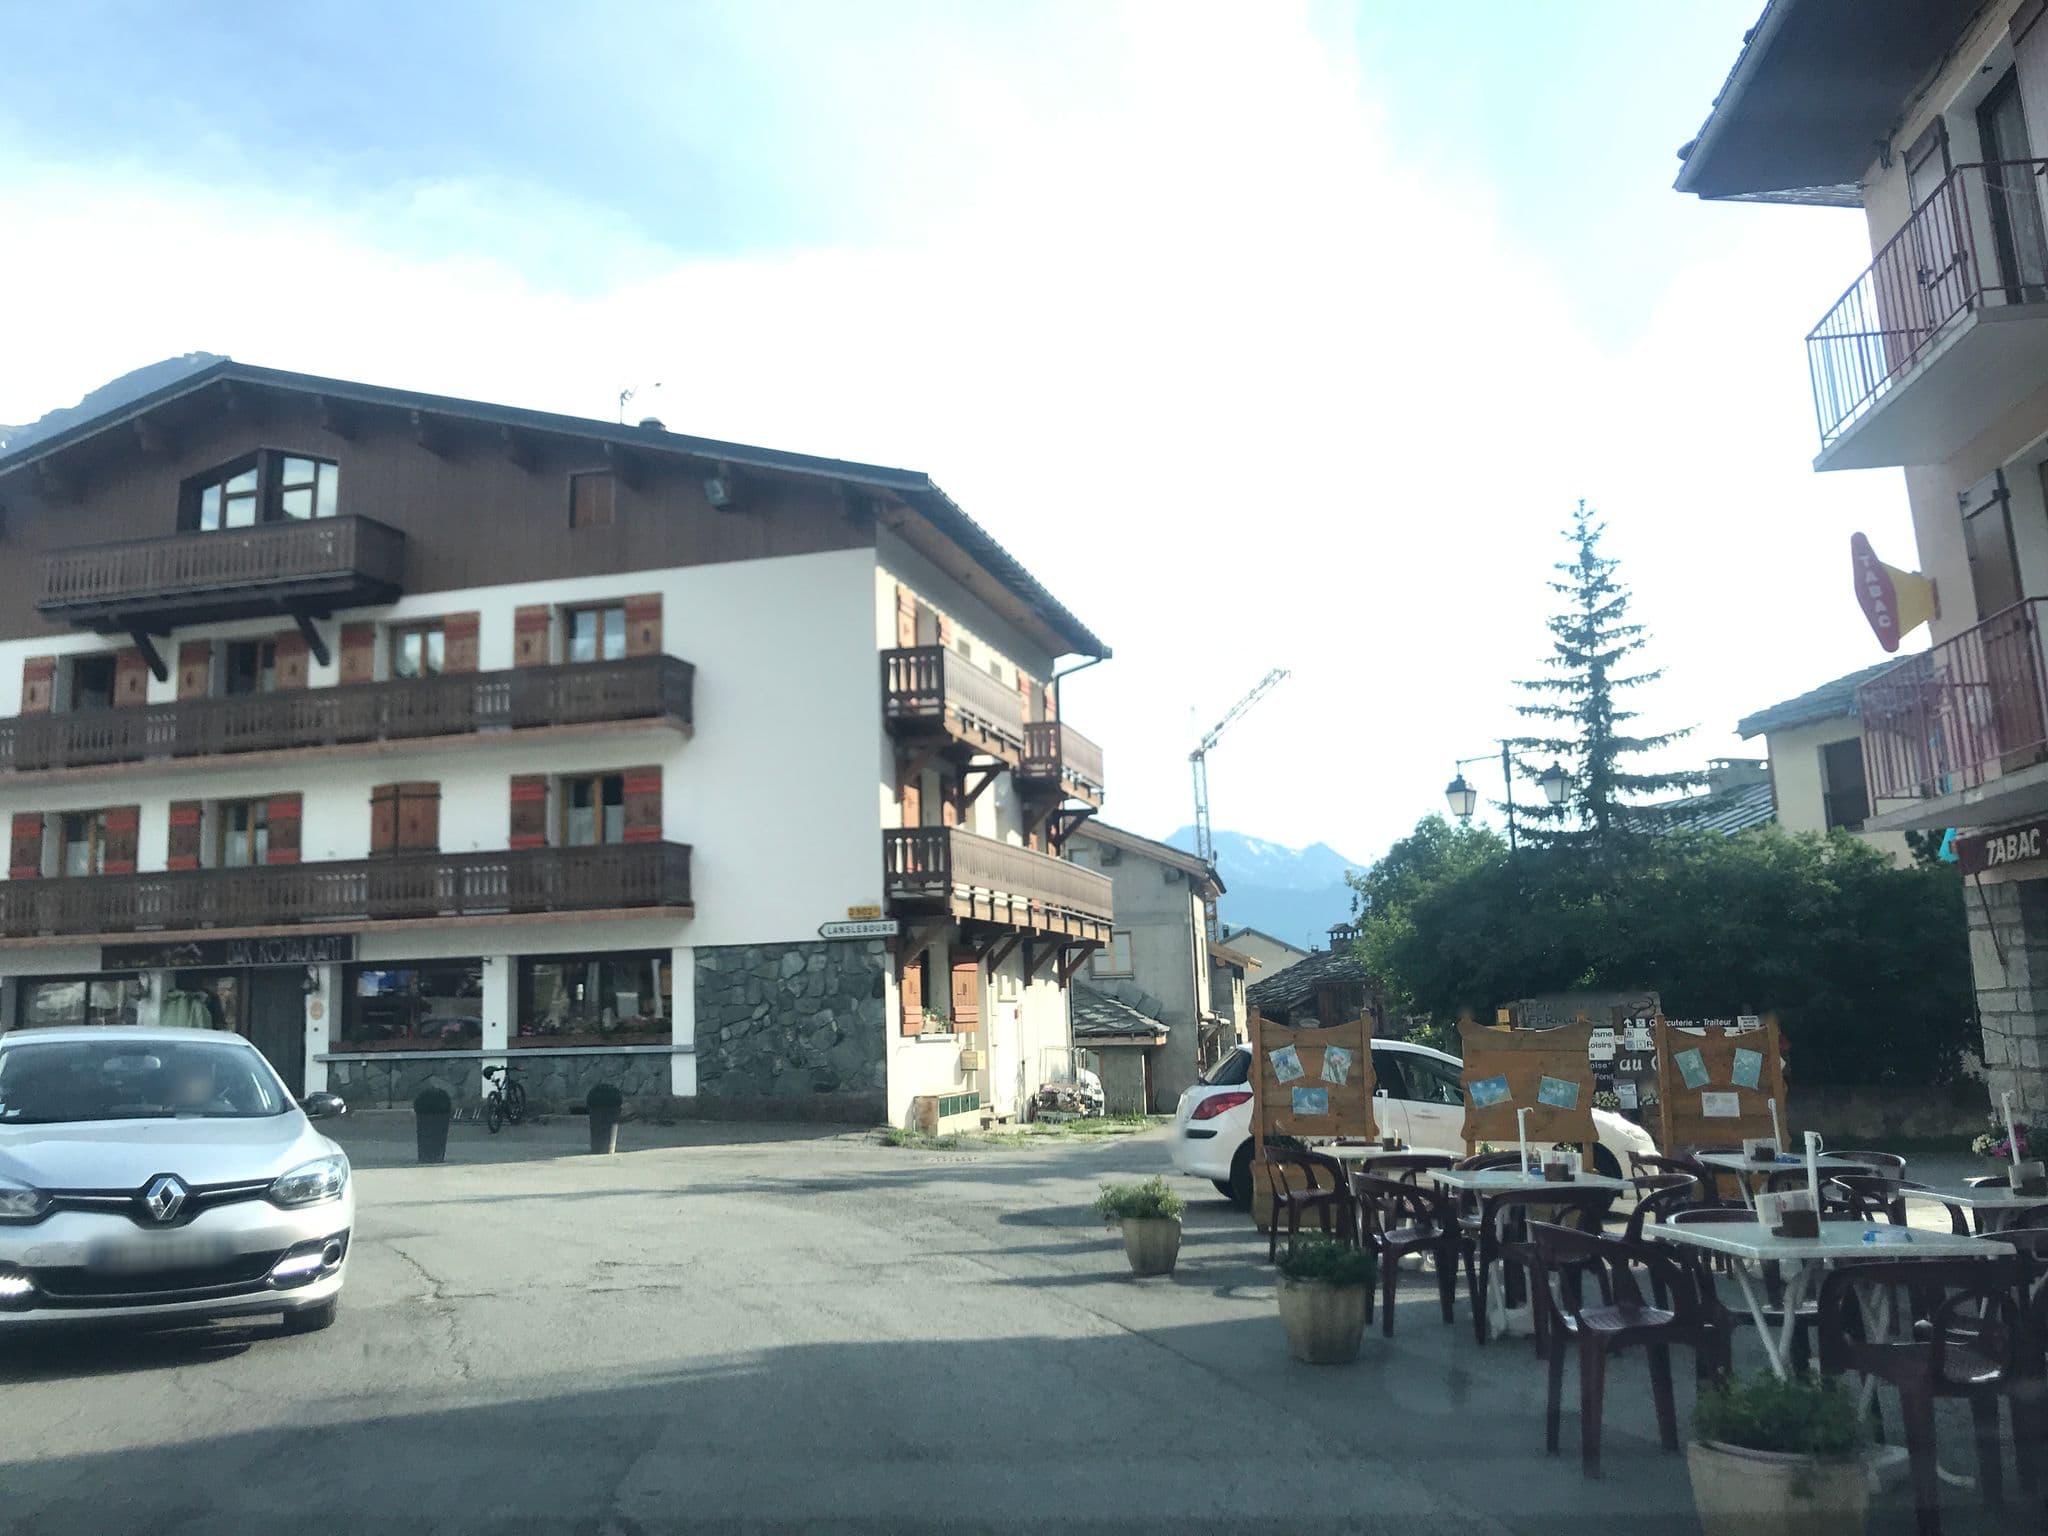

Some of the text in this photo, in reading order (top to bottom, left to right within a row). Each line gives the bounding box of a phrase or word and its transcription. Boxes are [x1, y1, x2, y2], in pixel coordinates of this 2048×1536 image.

[1858, 555, 1891, 627] TABAC
[1985, 828, 2041, 866] TABAC
[828, 924, 894, 934] LANSLEBOURG
[1703, 1018, 1732, 1026] Traiteur
[1620, 1059, 1642, 1070] au
